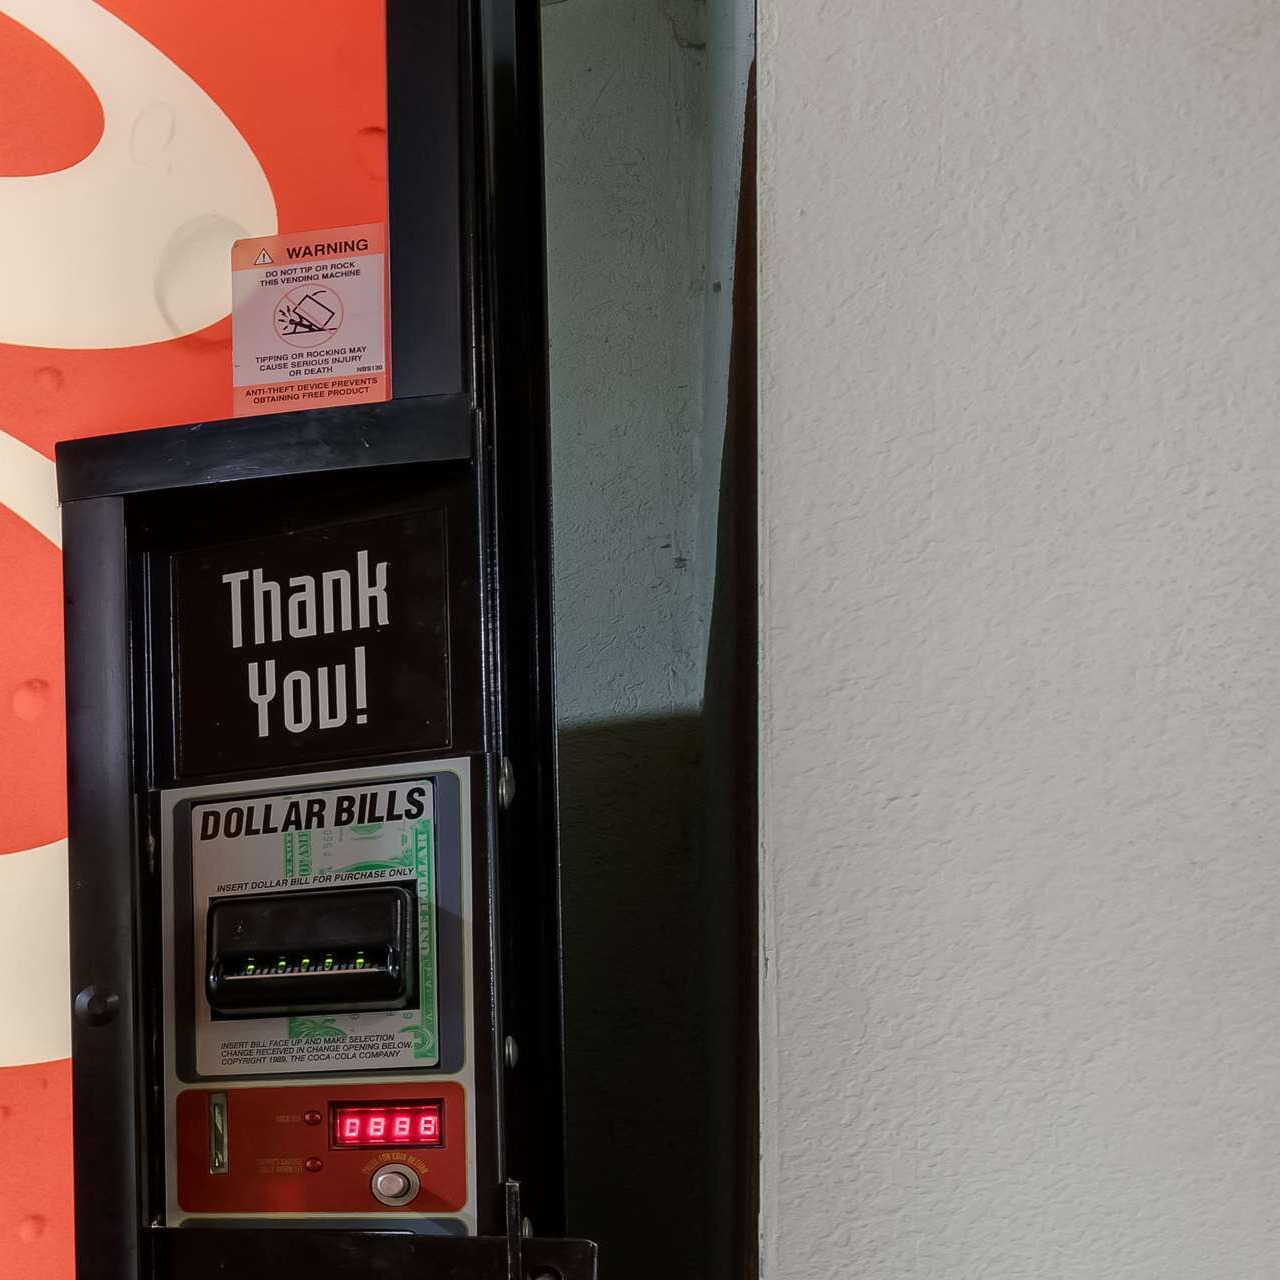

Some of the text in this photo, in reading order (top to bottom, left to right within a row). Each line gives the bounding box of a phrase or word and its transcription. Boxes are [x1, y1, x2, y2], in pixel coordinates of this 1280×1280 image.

[287, 238, 369, 259] WARNING
[260, 269, 361, 286] THIS VENDING MACHINE
[265, 261, 355, 278] DO NOT TIP OR ROCK
[255, 346, 367, 364] TIPPING OR ROCKING MAY
[259, 354, 363, 372] CAUSE SERIOUS INJURY
[289, 366, 333, 377] OR DEATH
[245, 376, 378, 398] ANTI-THEFT DEVICE PREVENTS
[253, 386, 369, 404] OBTAINING FREE PRODUCT
[221, 550, 389, 648] Thank
[247, 646, 368, 738] You!
[199, 786, 427, 842] DOLLAR BILLS
[217, 867, 415, 894] INSERT DOLLAR BILL FOR PURCHASE ONLY
[221, 1034, 395, 1050] INSERT BILL FACE UP AND MAKE SELECTION
